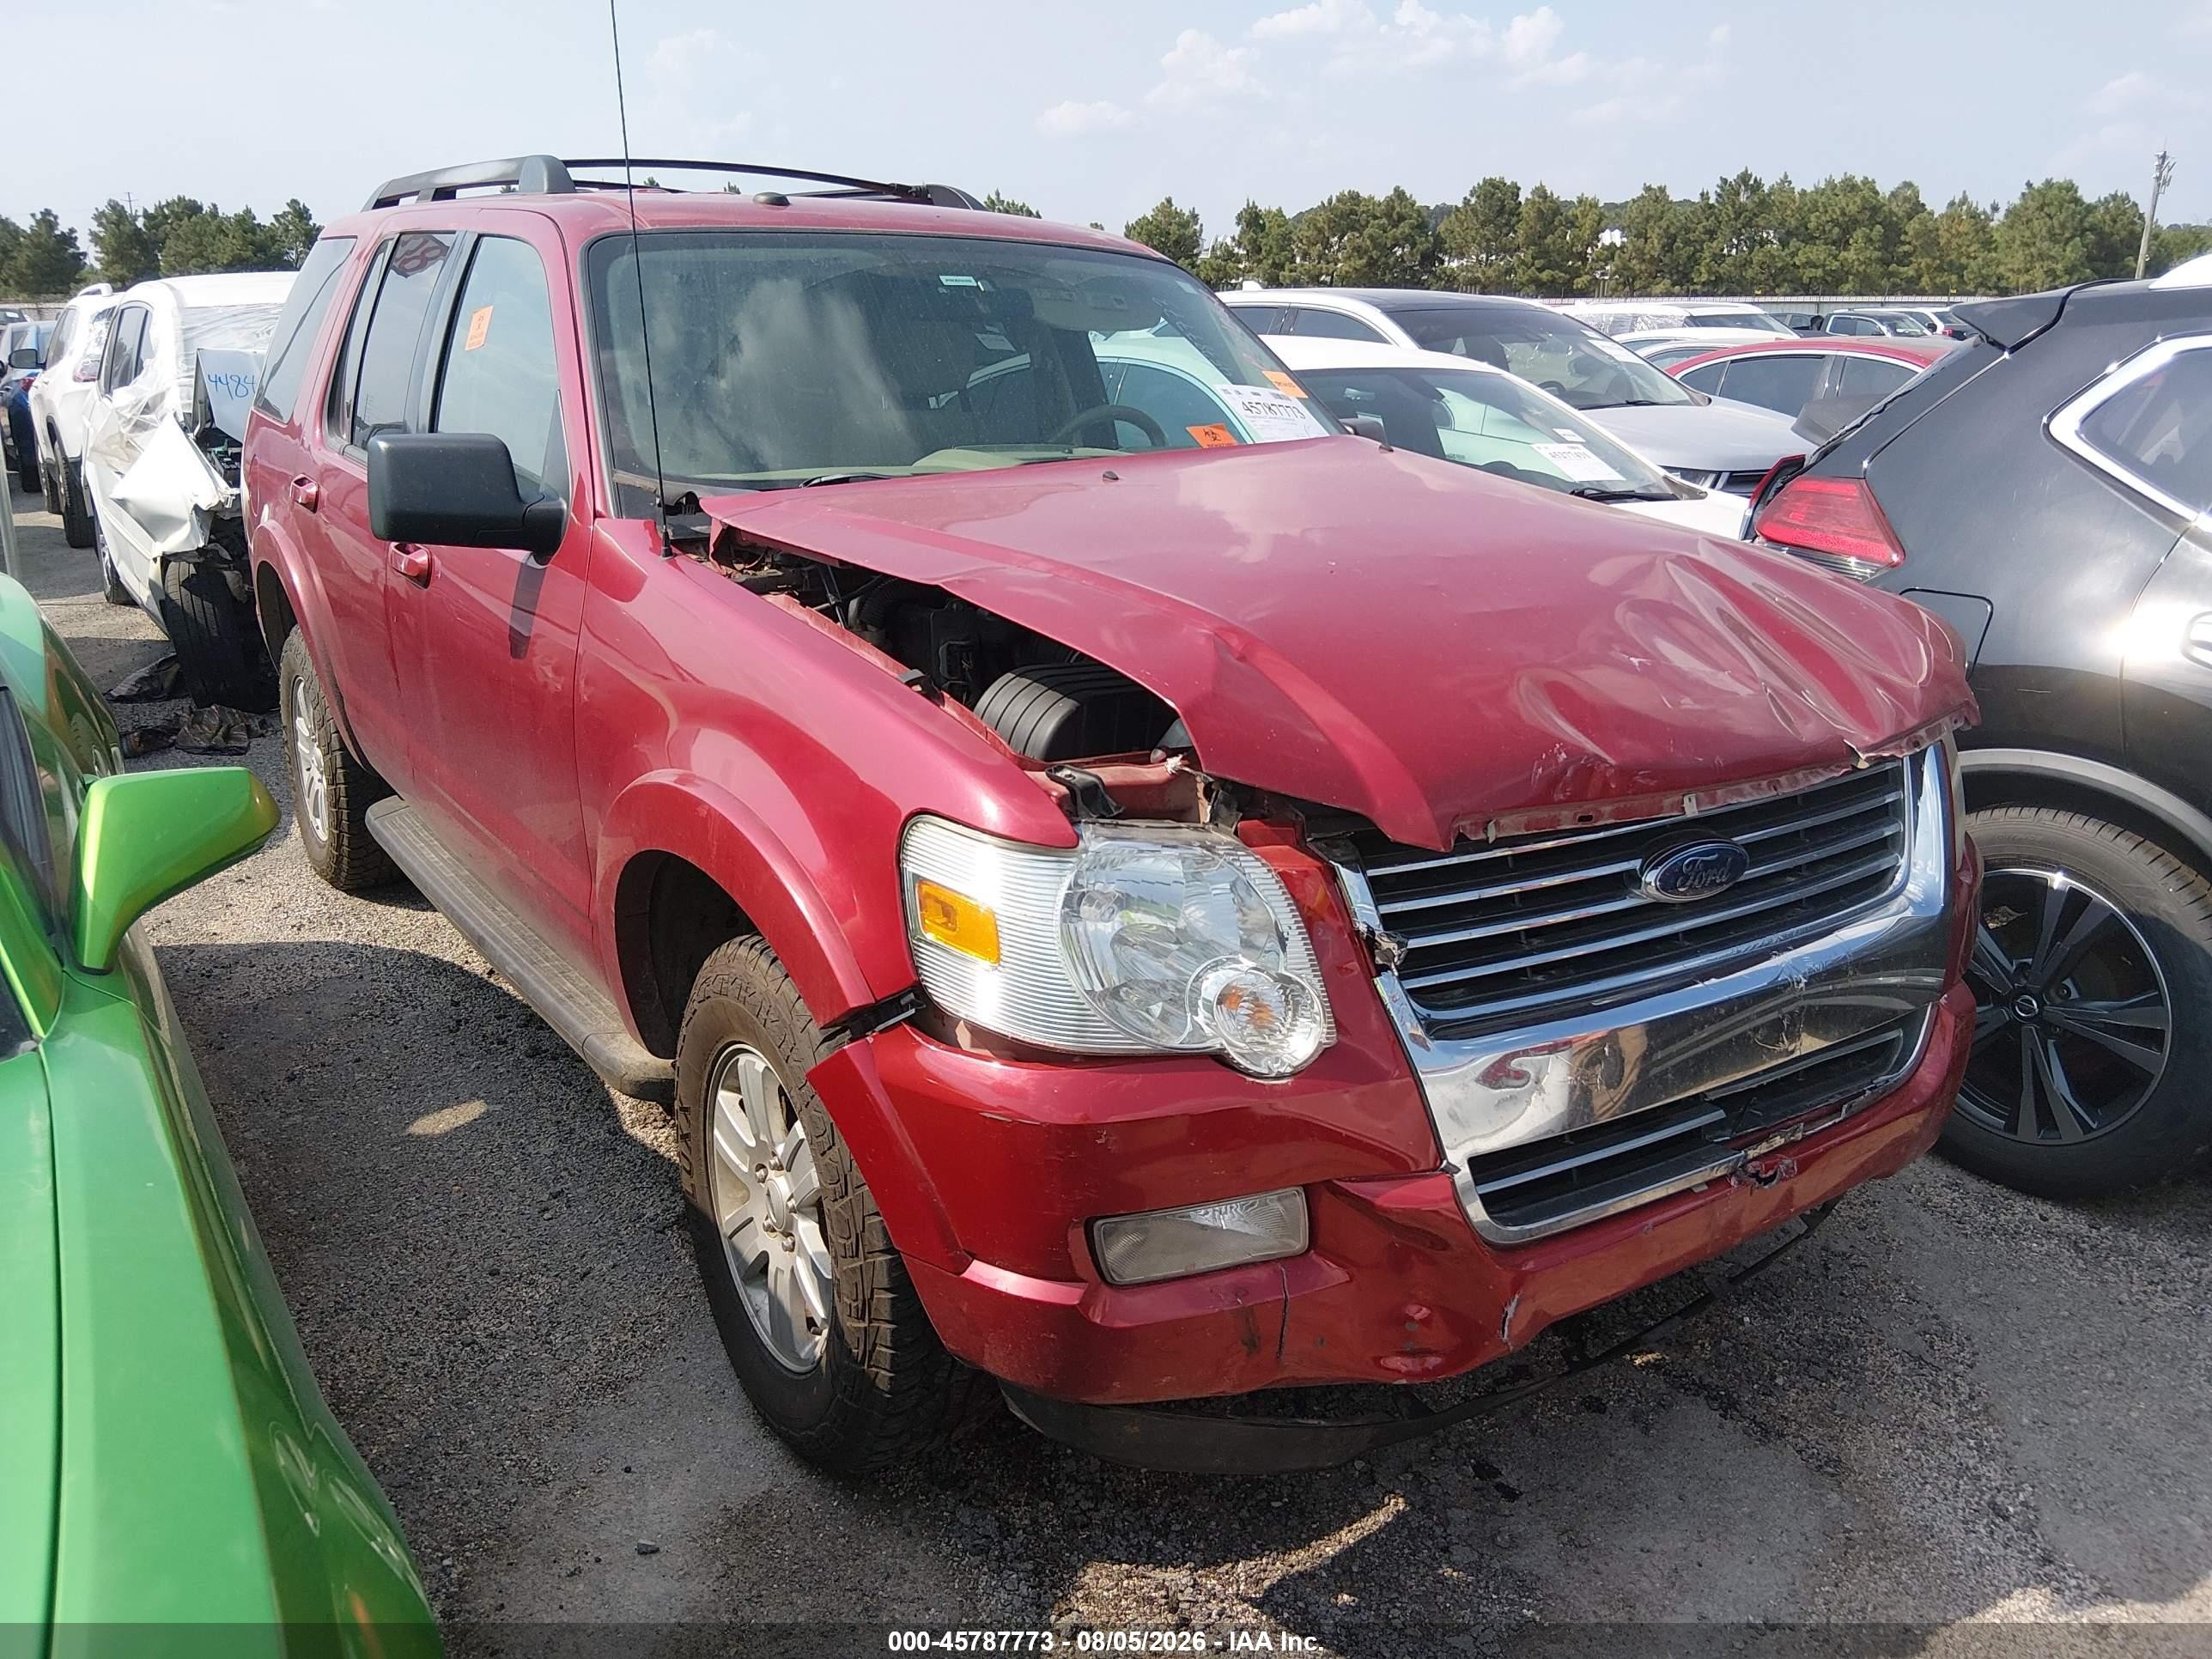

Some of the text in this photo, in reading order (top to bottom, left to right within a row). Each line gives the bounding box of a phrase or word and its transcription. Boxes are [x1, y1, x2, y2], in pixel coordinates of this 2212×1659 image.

[208, 374, 256, 400] 4484
[1242, 401, 1306, 420] 45787773
[1676, 854, 1731, 892] Ford
